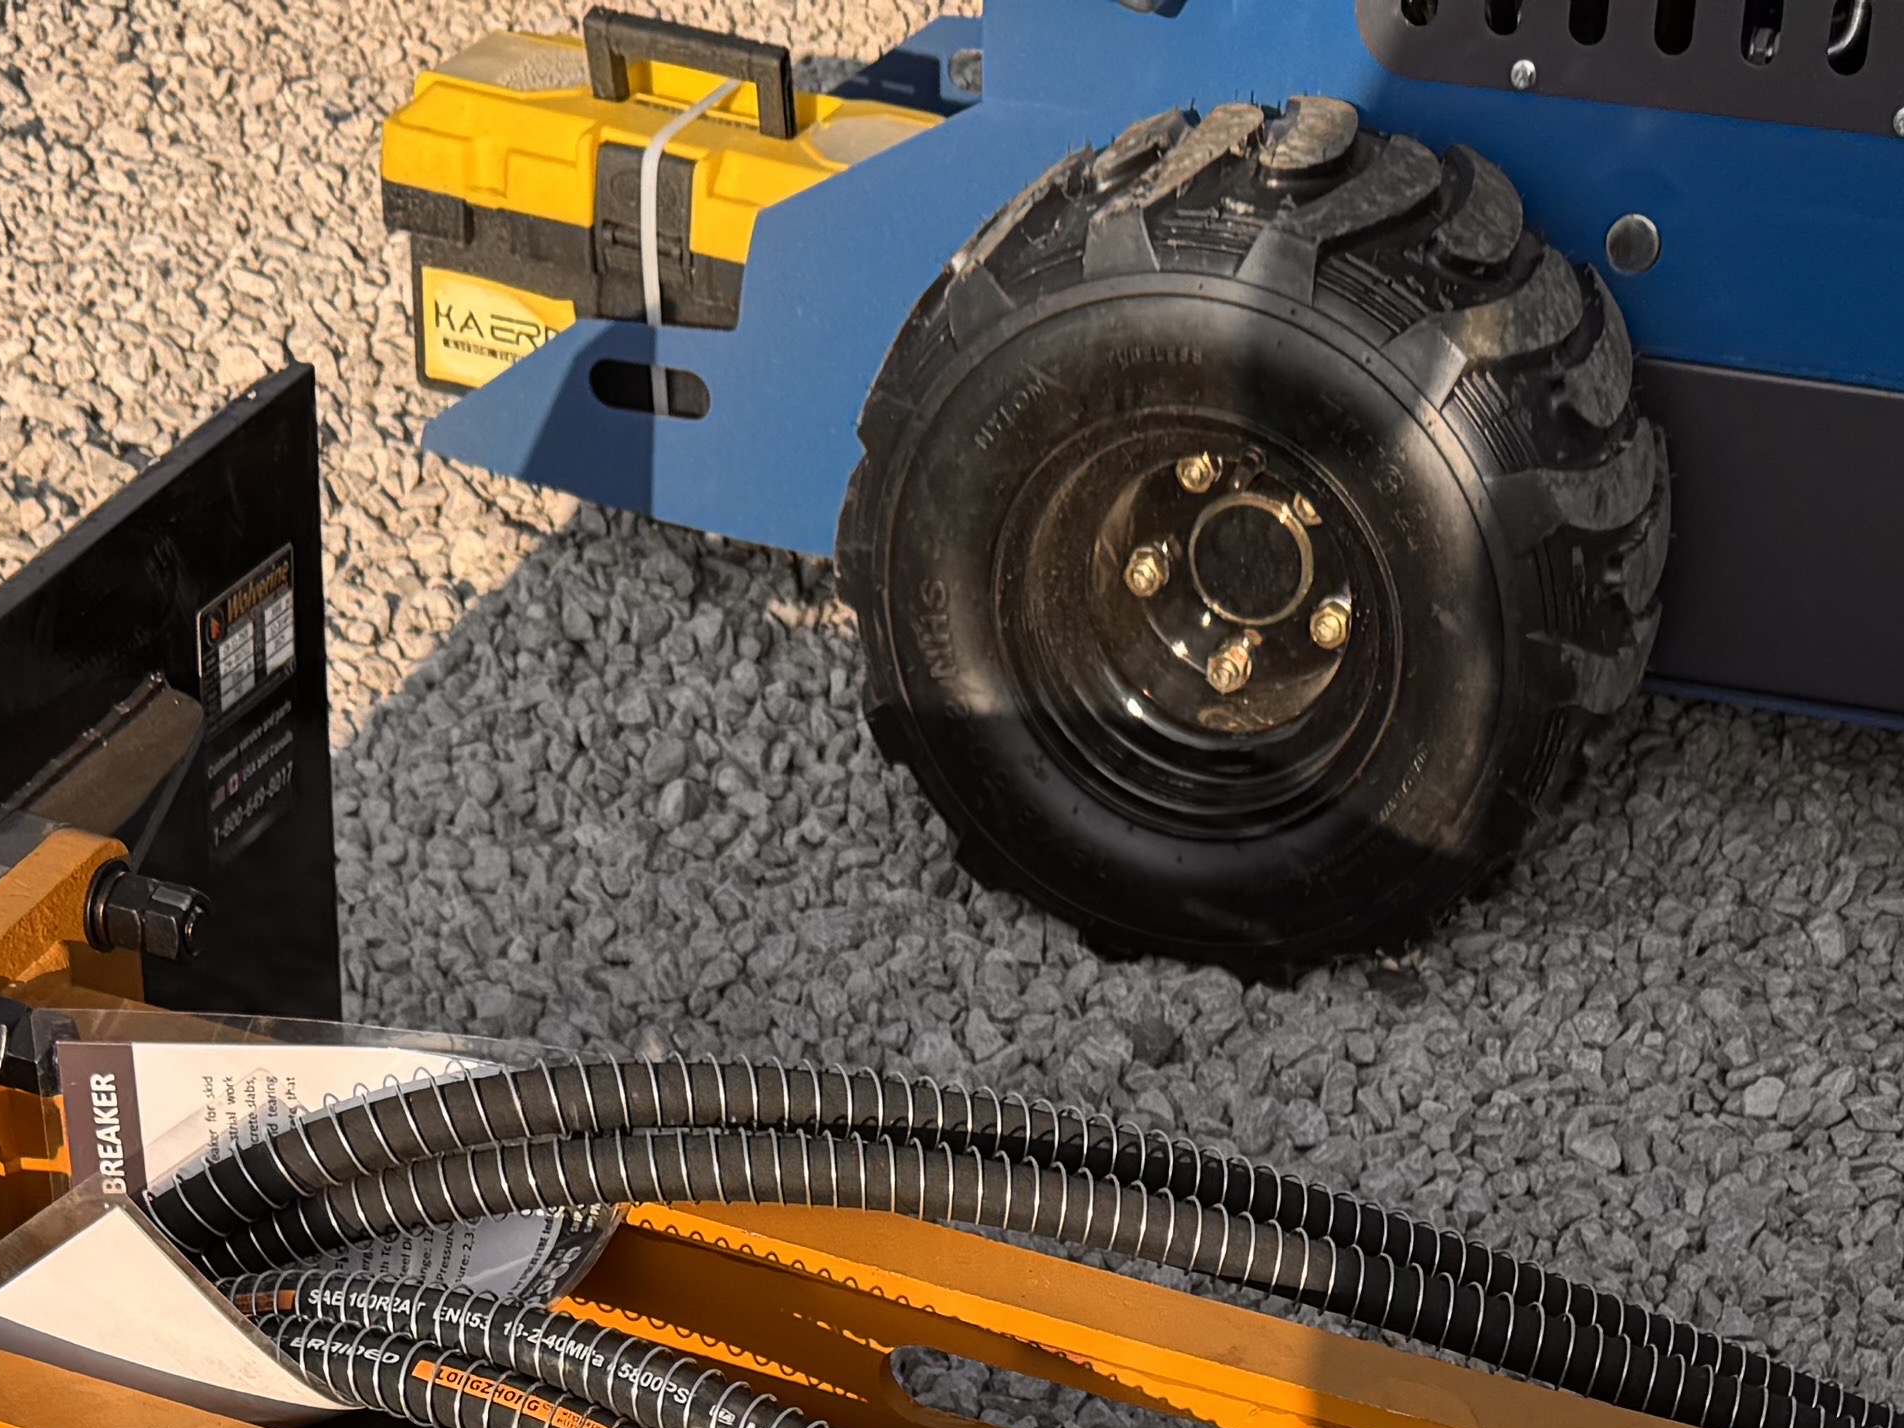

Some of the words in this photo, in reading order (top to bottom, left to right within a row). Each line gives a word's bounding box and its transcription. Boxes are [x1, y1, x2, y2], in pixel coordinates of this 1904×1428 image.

[203, 1076, 214, 1101] skid
[222, 1076, 234, 1105] work
[265, 1076, 279, 1118] tearing
[286, 1076, 297, 1102] that
[206, 1103, 217, 1124] for
[90, 1073, 128, 1195] BREAKER
[307, 1287, 345, 1307] SAE
[618, 1363, 693, 1405] 5800PS
